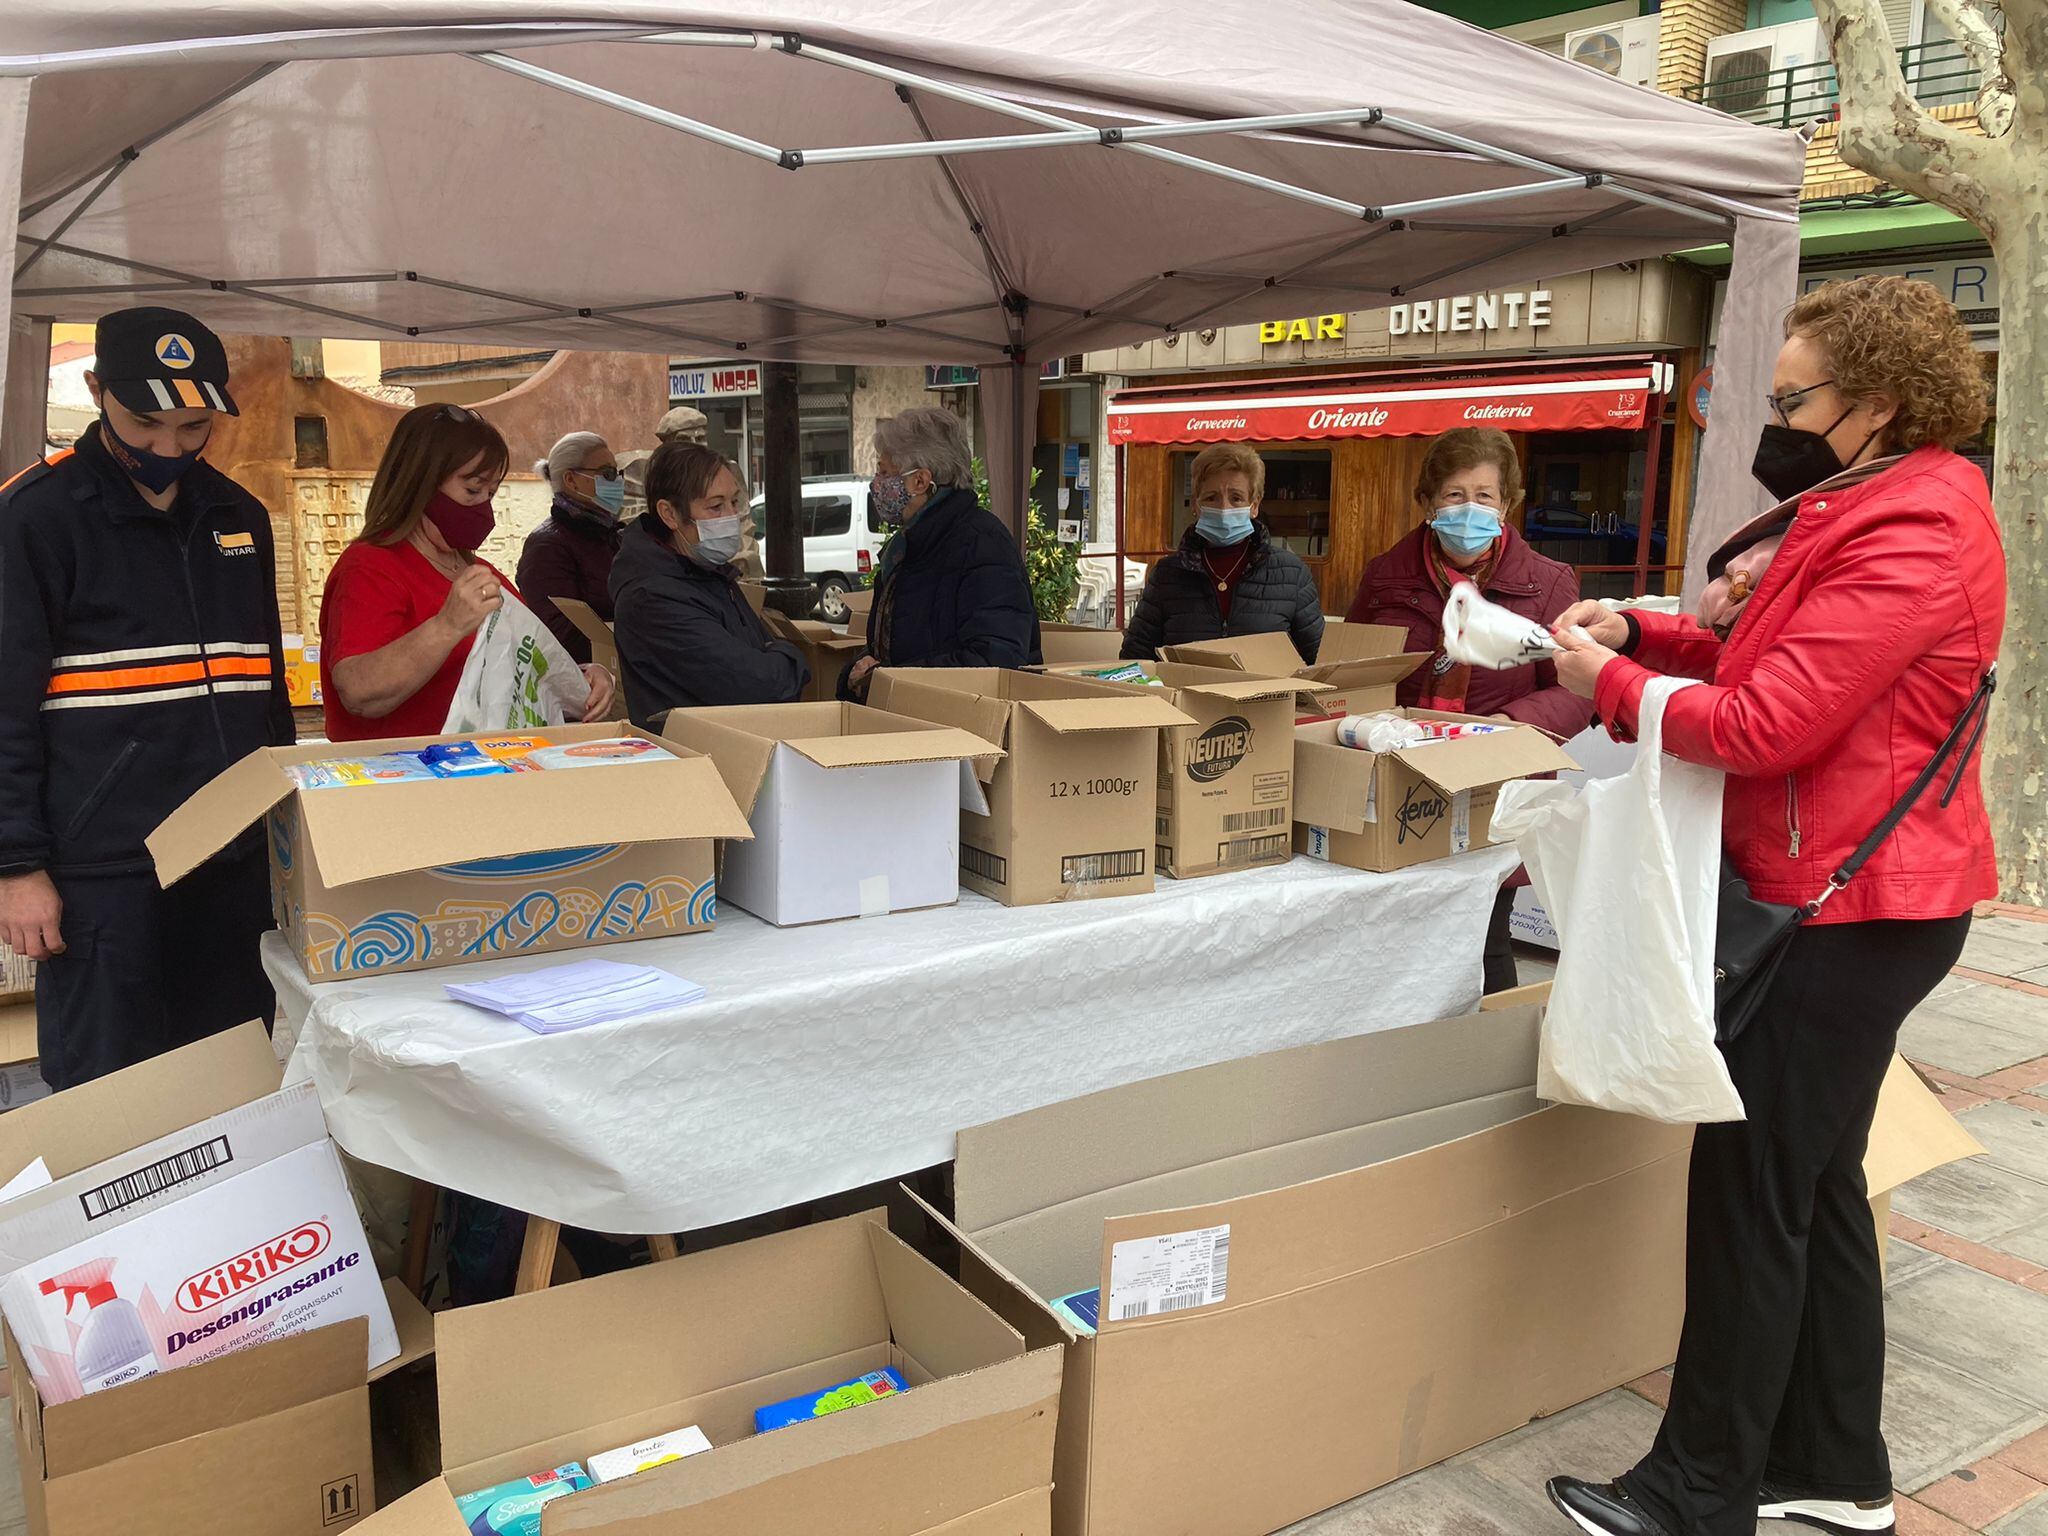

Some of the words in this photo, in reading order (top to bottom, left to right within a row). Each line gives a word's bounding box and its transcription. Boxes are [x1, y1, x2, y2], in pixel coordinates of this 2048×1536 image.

[1259, 313, 1345, 343] BAR
[1389, 290, 1553, 336] ORIENTE
[712, 369, 758, 393] MORA
[1308, 407, 1389, 430] Oriente
[1463, 402, 1533, 420] Cafetería
[1183, 728, 1256, 766] NEUTREX
[1049, 781, 1068, 798] 12
[1072, 784, 1081, 796] x
[1086, 777, 1139, 796] 1000gr
[166, 1252, 360, 1355] Desengrasante
